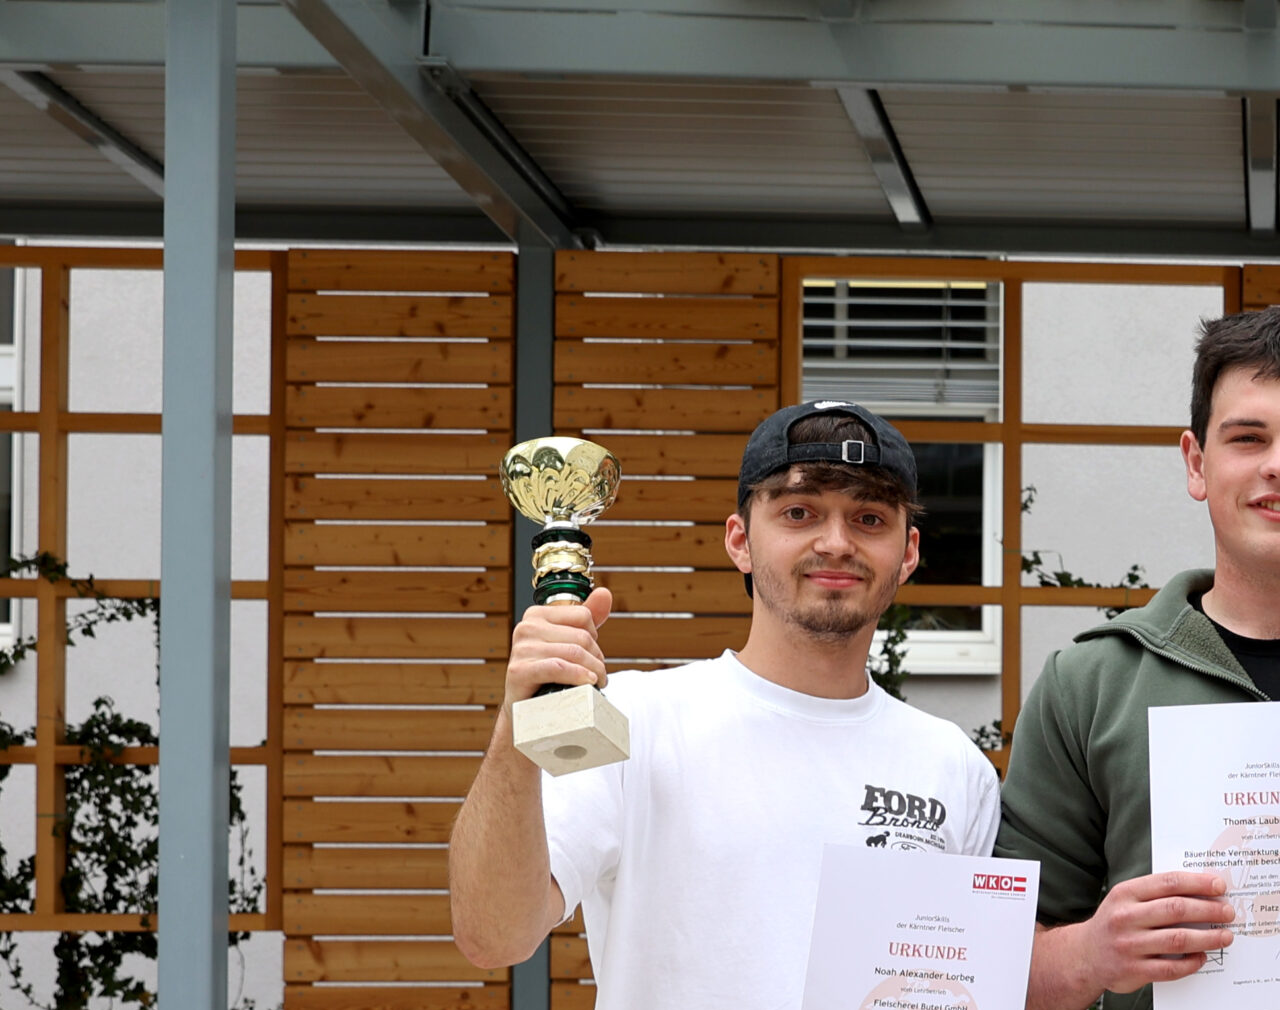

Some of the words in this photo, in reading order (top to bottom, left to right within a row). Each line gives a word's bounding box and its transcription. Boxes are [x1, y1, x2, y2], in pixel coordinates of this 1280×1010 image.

[1245, 762, 1280, 770] JuniorSkills
[1240, 770, 1267, 779] Kärntner
[860, 784, 947, 827] FORD
[857, 806, 940, 832] Bronco
[1223, 817, 1256, 826] Thomas
[1228, 848, 1279, 858] Vermarktung
[1182, 858, 1243, 868] Genossenschaft
[1245, 857, 1260, 866] mit
[973, 874, 1012, 891] WKO
[915, 914, 950, 923] JuniorSkills
[896, 922, 907, 930] der
[909, 923, 936, 932] Kärntner
[938, 925, 965, 934] Fleischer
[889, 942, 968, 961] URKUNDE
[874, 967, 897, 977] Noah
[900, 969, 943, 980] Alexander
[946, 972, 975, 983] Lorbeg
[873, 998, 919, 1010] Fleischerei
